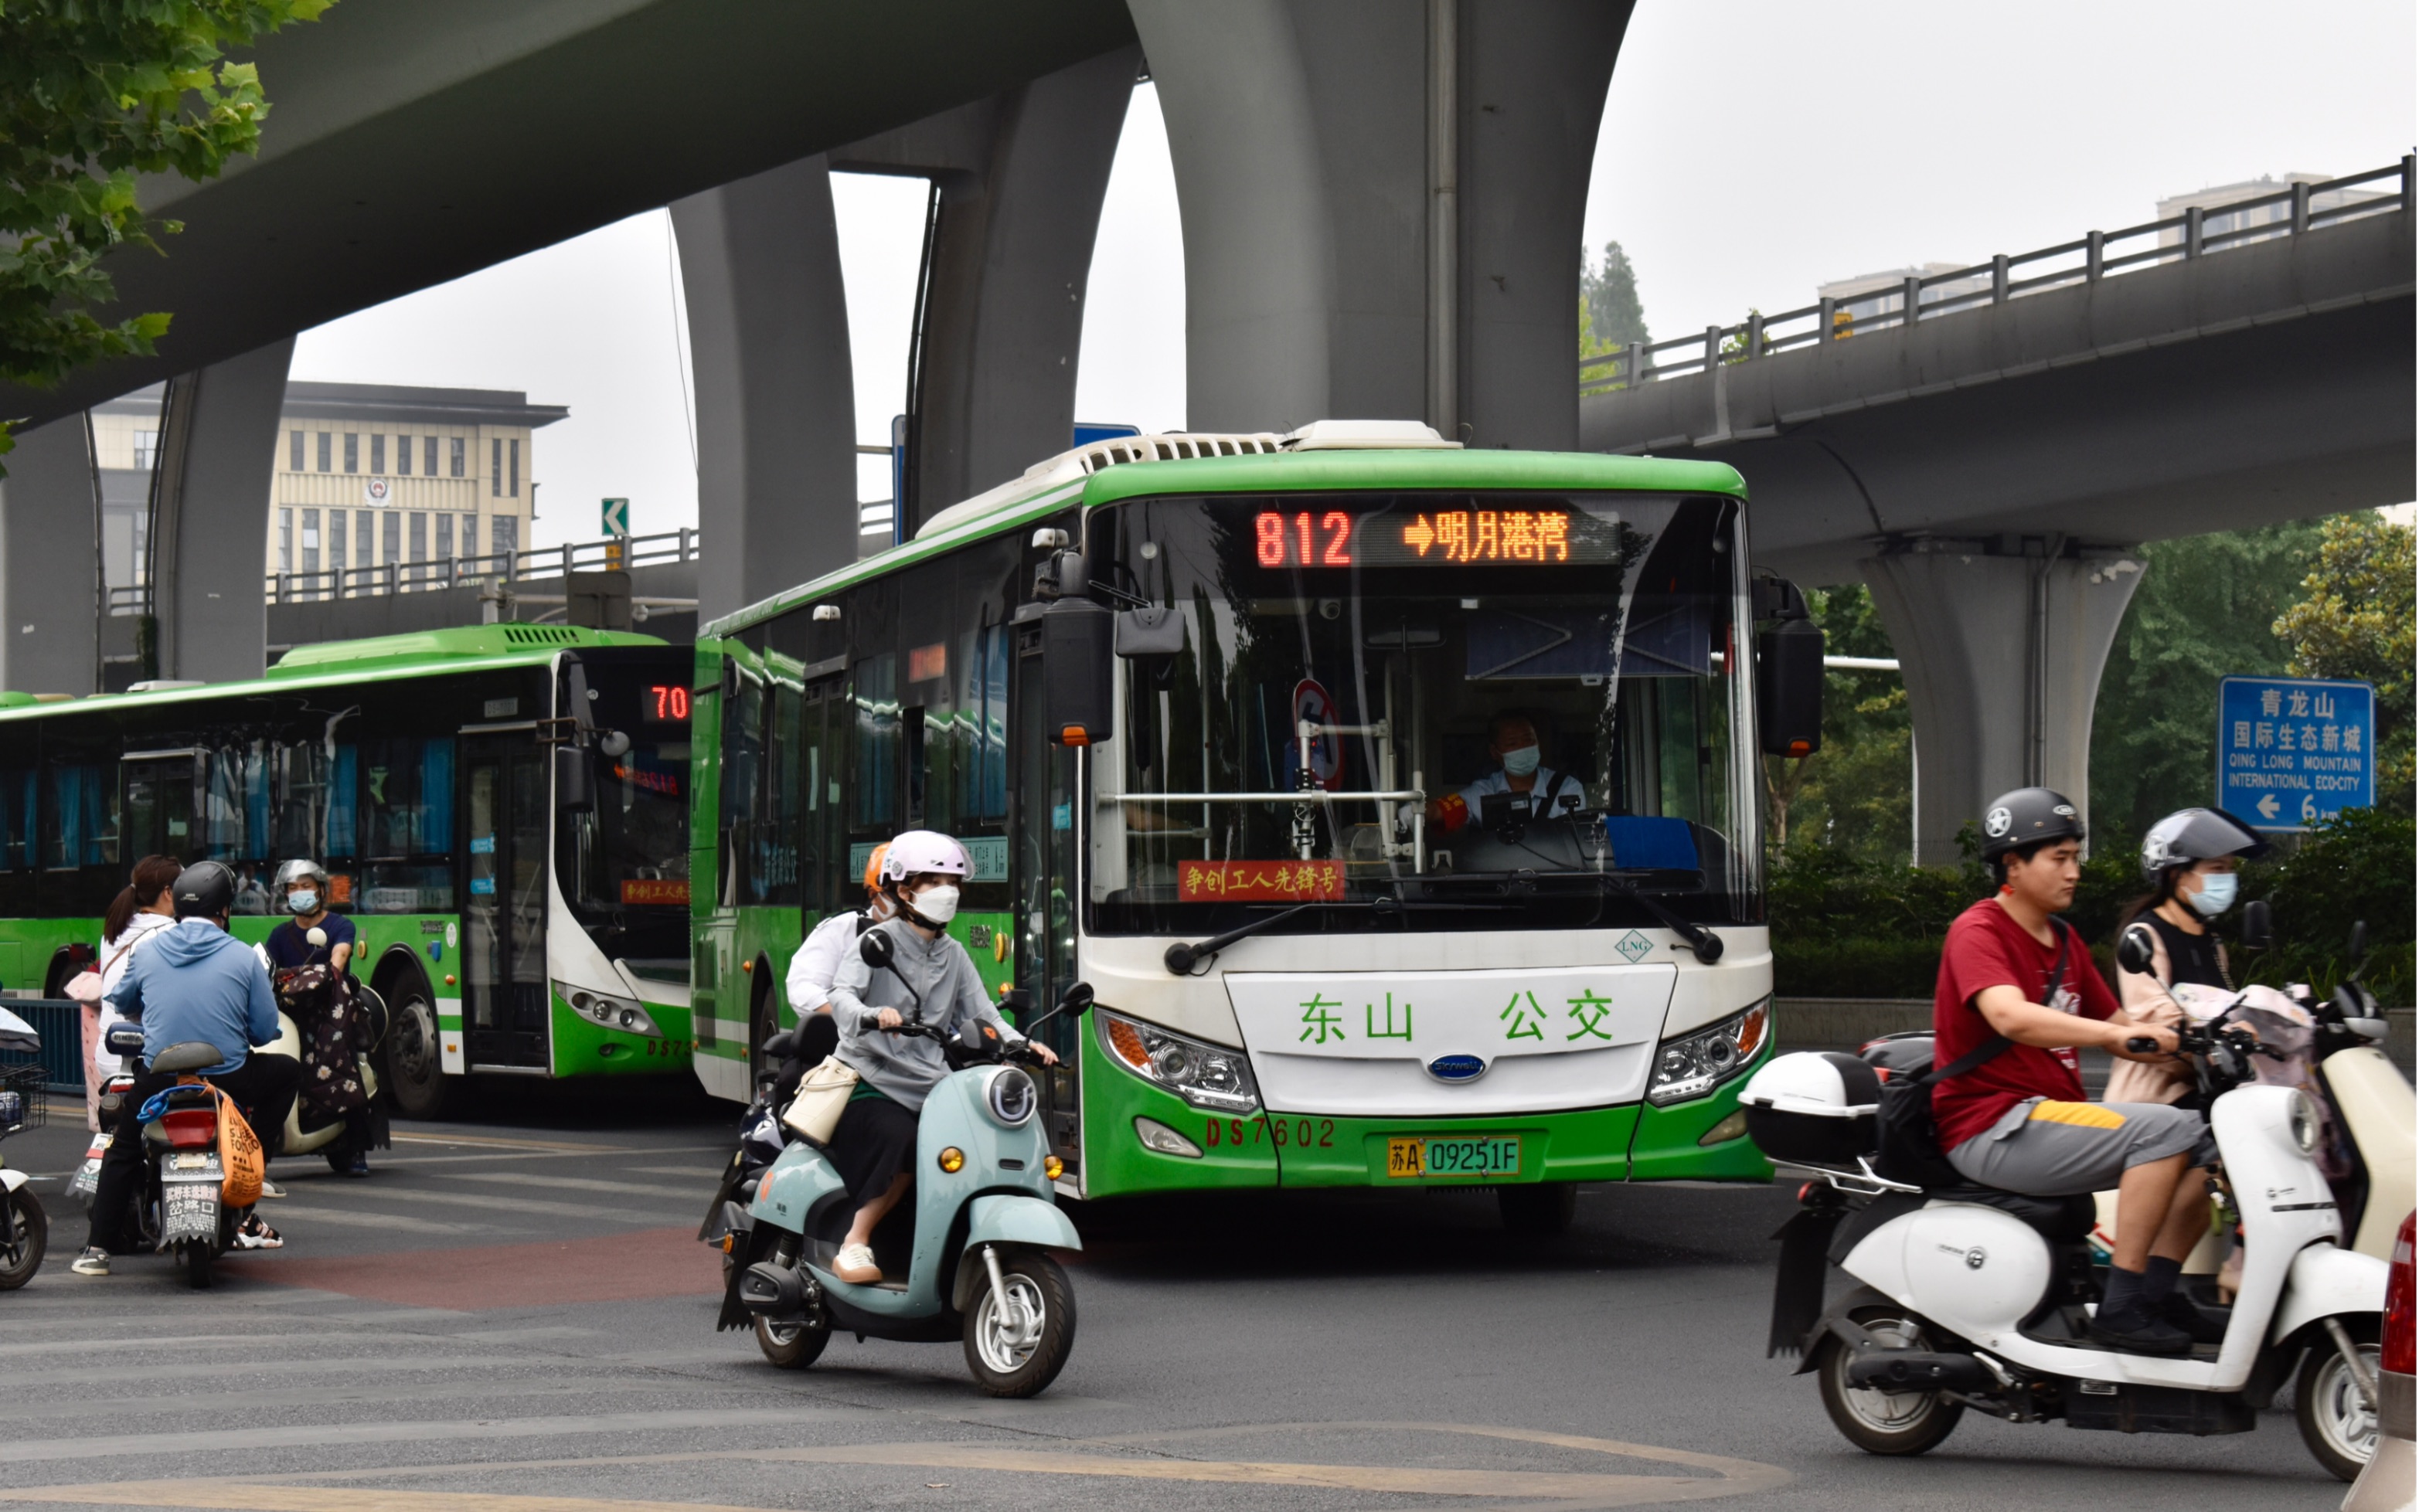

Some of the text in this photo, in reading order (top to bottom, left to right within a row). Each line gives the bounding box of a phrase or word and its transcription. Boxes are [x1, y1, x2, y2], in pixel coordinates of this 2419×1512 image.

[1257, 512, 1351, 565] 812
[1436, 511, 1568, 562] 明月港湾
[652, 686, 688, 719] 70
[2261, 688, 2335, 719] 青龙山
[2234, 721, 2362, 753] 国际生态新城
[2229, 753, 2362, 772] QING LONG MOUNTAIN
[2229, 773, 2360, 792] INTERNATIONAL ECO-CITY
[2301, 793, 2317, 821] 6
[1186, 866, 1338, 895] 争创工人先锋号
[1622, 940, 1648, 952] LNG
[1298, 987, 1613, 1045] 东山 公交
[1206, 1117, 1335, 1148] DS7602
[1391, 1142, 1518, 1171] 苏A 09251F
[168, 1199, 216, 1217] 岔路口
